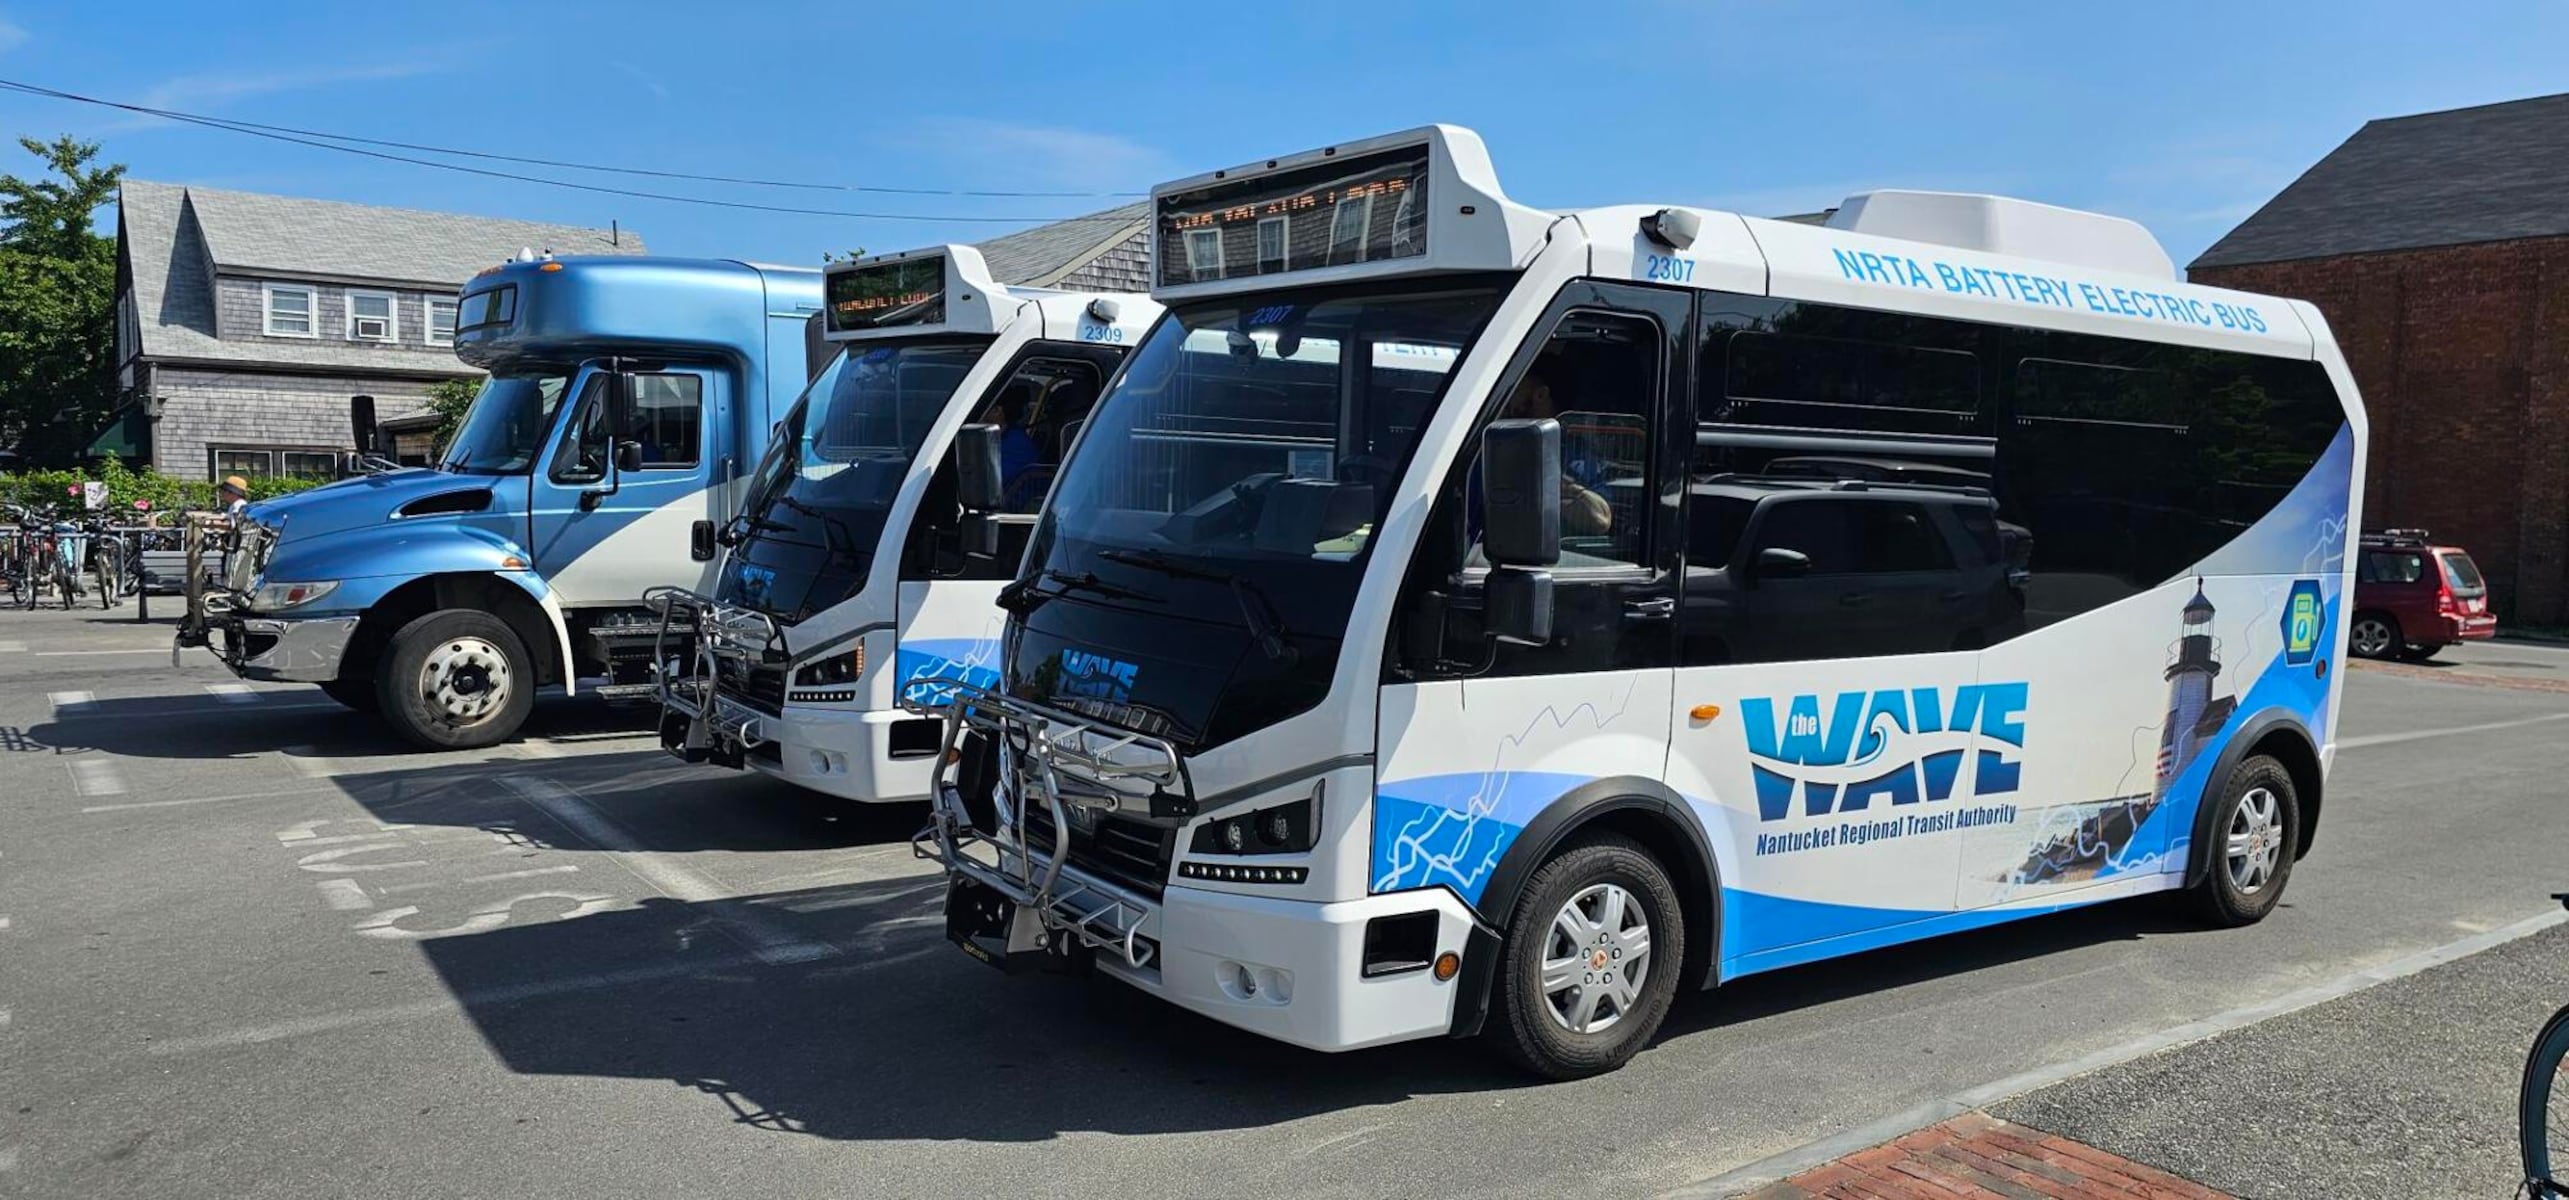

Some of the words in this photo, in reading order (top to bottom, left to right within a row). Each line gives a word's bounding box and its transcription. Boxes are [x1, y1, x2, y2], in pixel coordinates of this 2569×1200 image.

[1647, 254, 1695, 282] 2307
[1832, 248, 1934, 289] NRTA
[1933, 262, 2074, 308] BATTERY
[2078, 283, 2212, 326] ELECTRIC
[2211, 302, 2268, 333] BUS
[1085, 325, 1122, 342] 2309
[1249, 304, 1294, 325] 2307
[1056, 648, 1139, 703] WAVE
[1791, 712, 1817, 736] the
[1740, 682, 2029, 822] WAVE
[1756, 827, 1836, 856] Nantucket
[1839, 816, 1903, 845] Regional
[1906, 811, 1954, 835] Transit
[1956, 804, 2017, 829] Authority
